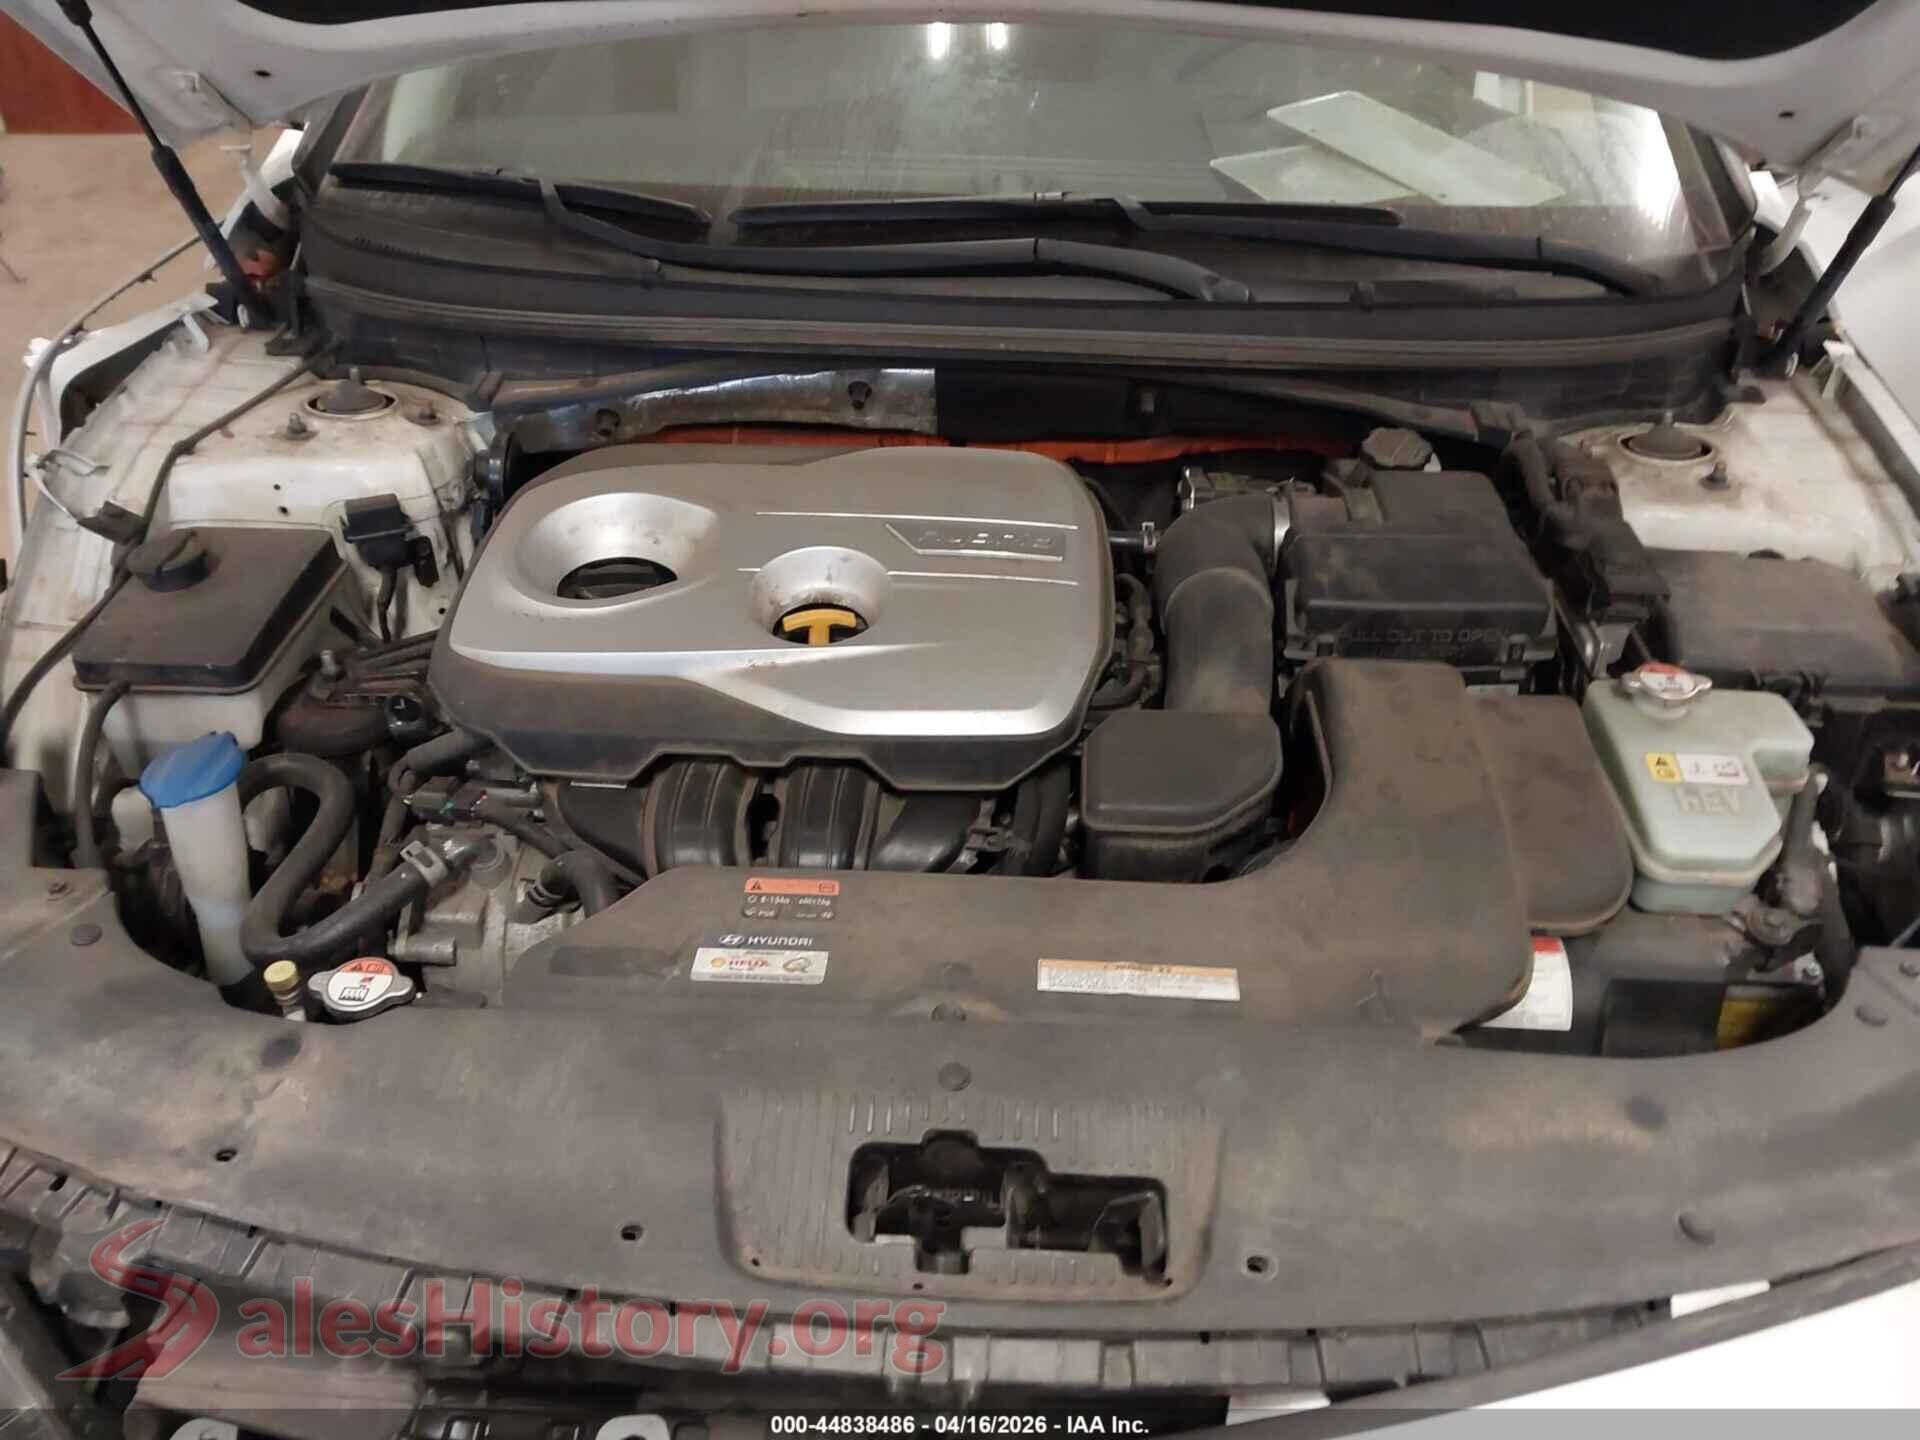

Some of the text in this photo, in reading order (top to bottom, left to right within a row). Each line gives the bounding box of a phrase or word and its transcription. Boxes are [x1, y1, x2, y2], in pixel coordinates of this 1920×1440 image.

[1387, 628, 1426, 642] OUT
[1431, 629, 1454, 642] TO
[747, 935, 814, 947] HYUNDAI
